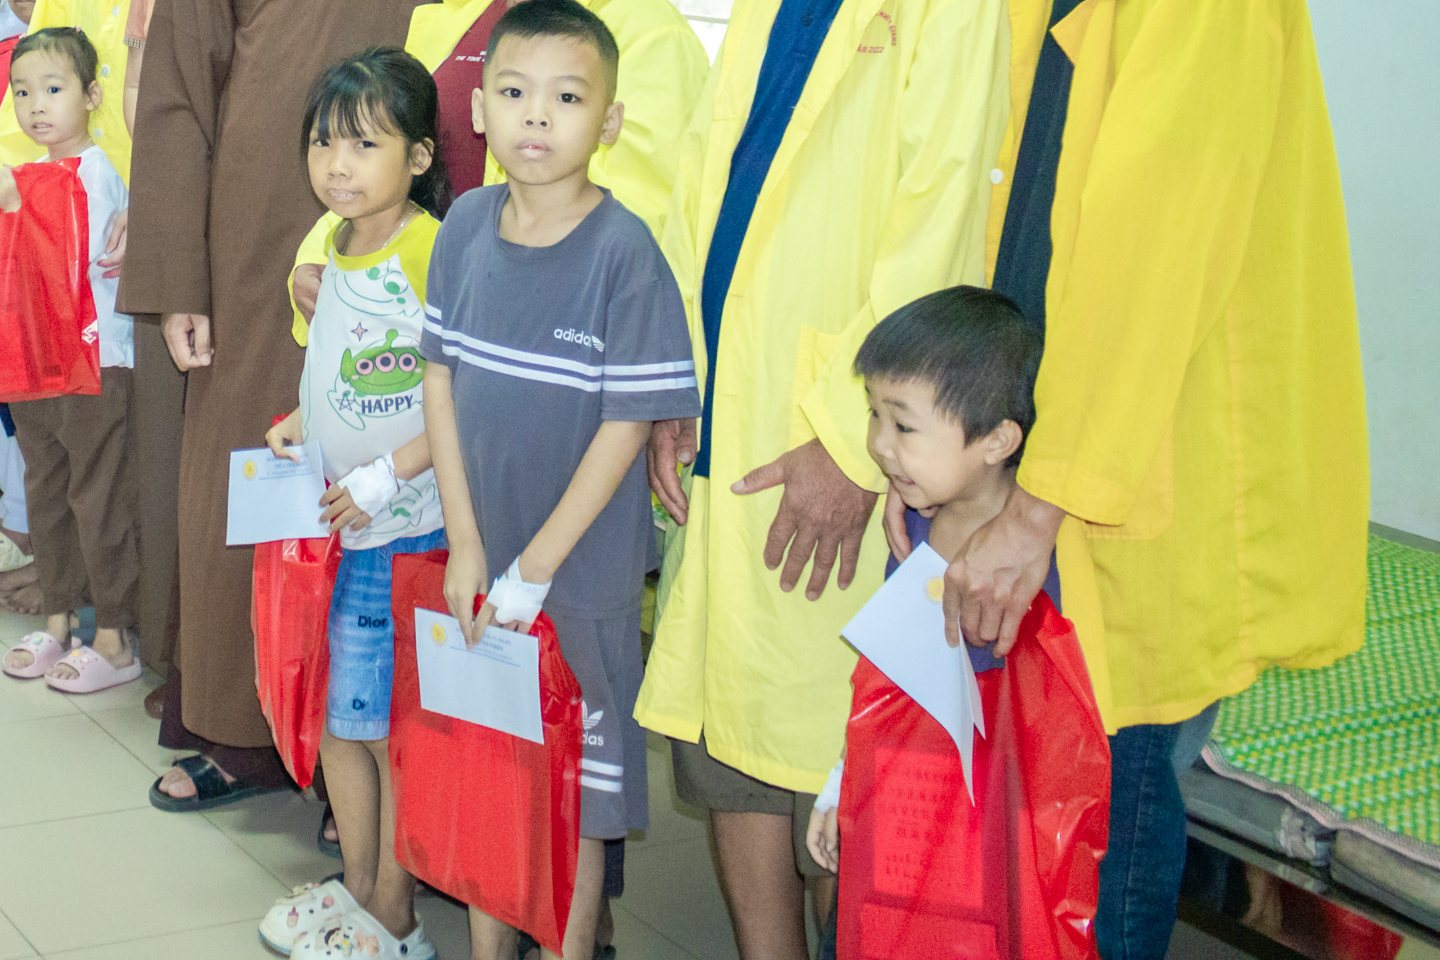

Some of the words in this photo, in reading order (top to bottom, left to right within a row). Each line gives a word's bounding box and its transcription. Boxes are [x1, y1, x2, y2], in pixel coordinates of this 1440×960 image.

[553, 327, 592, 347] adida
[361, 394, 413, 414] HAPPY
[357, 615, 388, 628] Dior
[582, 731, 604, 746] das
